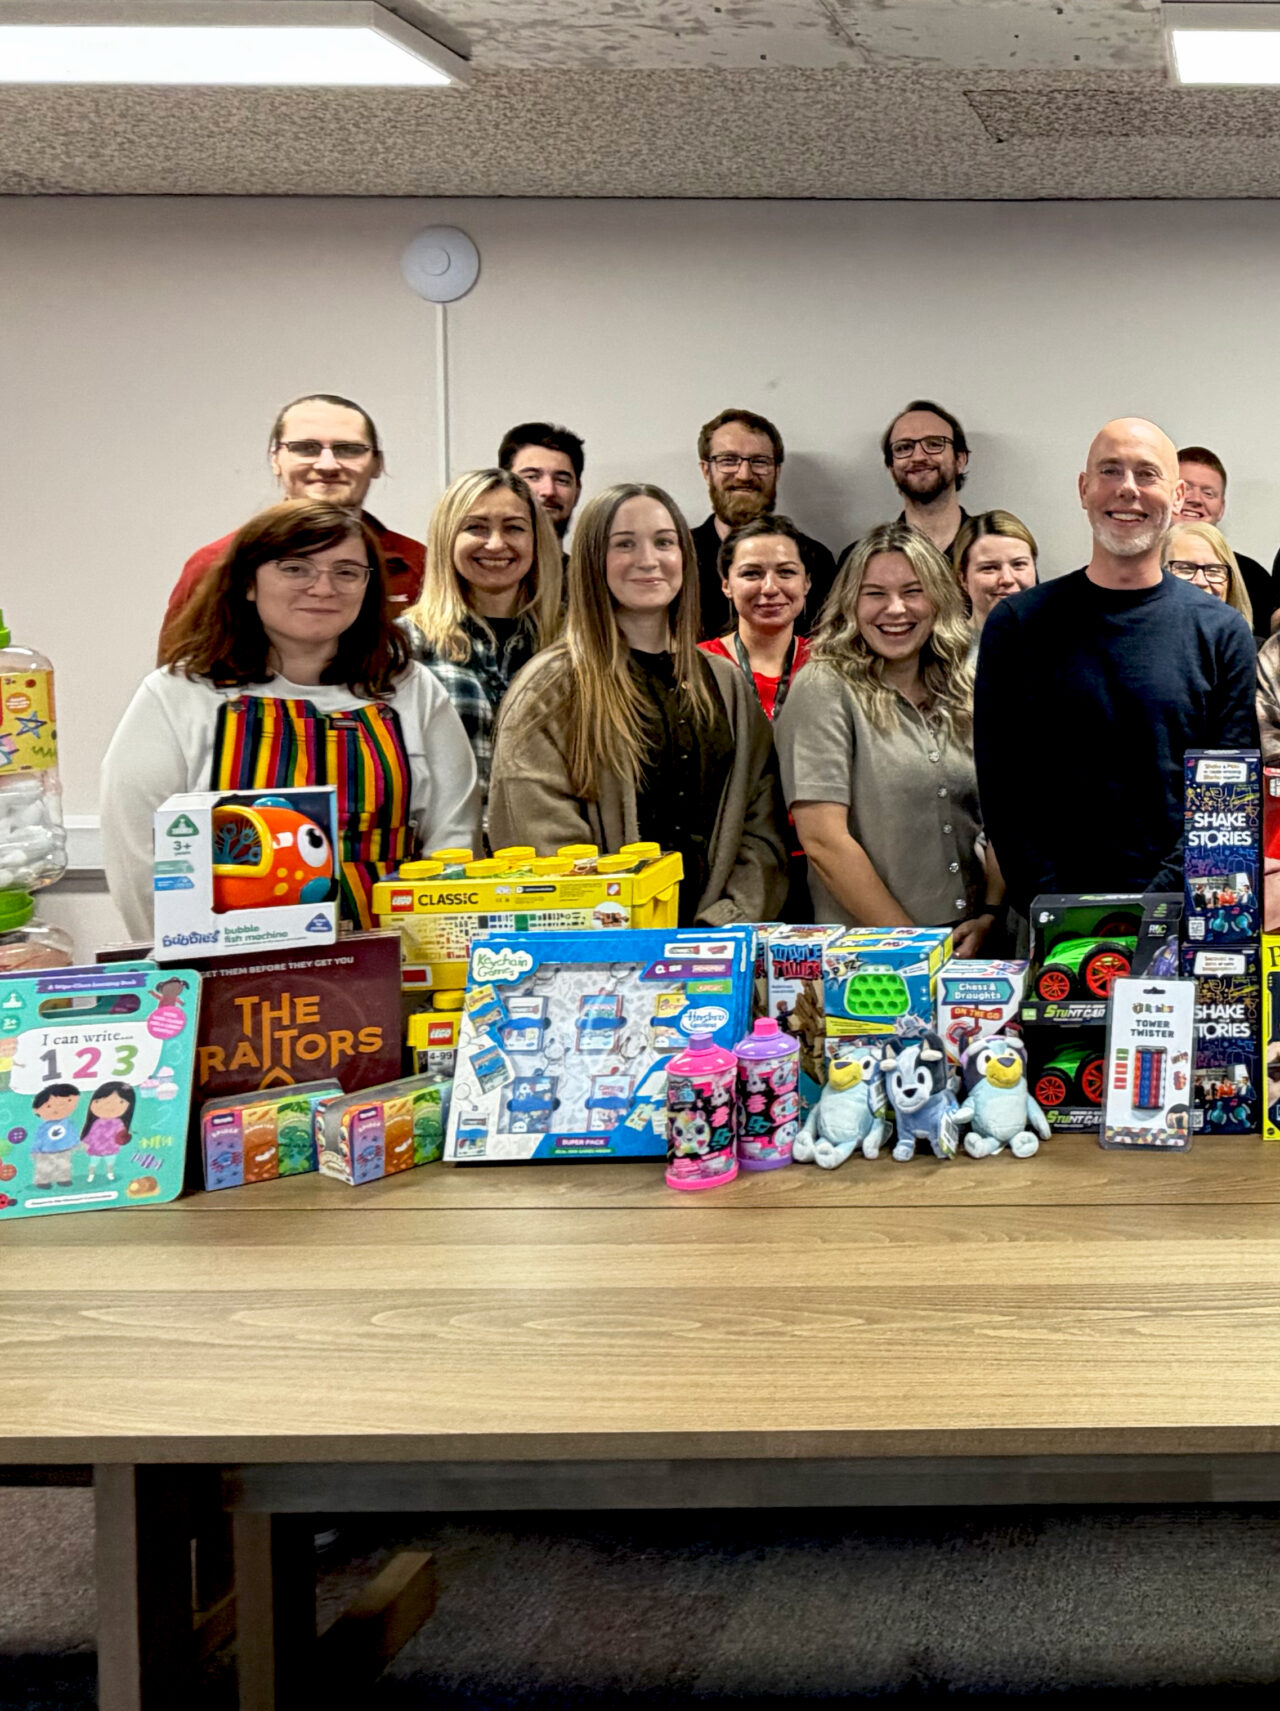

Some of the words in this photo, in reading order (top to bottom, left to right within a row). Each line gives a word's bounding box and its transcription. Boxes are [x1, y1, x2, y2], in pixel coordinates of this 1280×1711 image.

[1194, 812, 1246, 828] SHAKE
[173, 840, 192, 851] 3+
[1188, 831, 1252, 847] STORIES
[418, 892, 479, 907] CLASSIC
[1039, 911, 1055, 923] 6+
[224, 925, 260, 935] bubble
[245, 930, 289, 942] machine
[220, 967, 248, 977] THEM
[249, 963, 286, 974] BEFORE
[288, 960, 313, 969] THEY
[314, 958, 333, 967] GET
[334, 956, 354, 965] YOU
[477, 953, 528, 970] Keychain
[959, 983, 987, 991] Chess
[954, 992, 1001, 1001] Draughts
[234, 993, 320, 1037] THE
[969, 1009, 984, 1018] THE
[987, 1010, 1001, 1019] GO
[1044, 1004, 1081, 1018] STUNT
[1194, 1004, 1245, 1019] SHAKE
[1135, 1019, 1170, 1028] TOWER
[1130, 1029, 1174, 1038] TWISTER
[1195, 1022, 1251, 1040] TORIES
[42, 1034, 49, 1046] I
[53, 1036, 78, 1045] can
[83, 1031, 134, 1042] write...
[197, 1026, 383, 1086] RAITORS
[39, 1049, 62, 1082] 1
[72, 1047, 102, 1079] 2
[111, 1045, 139, 1077] 3
[1047, 1110, 1084, 1124] STUNT
